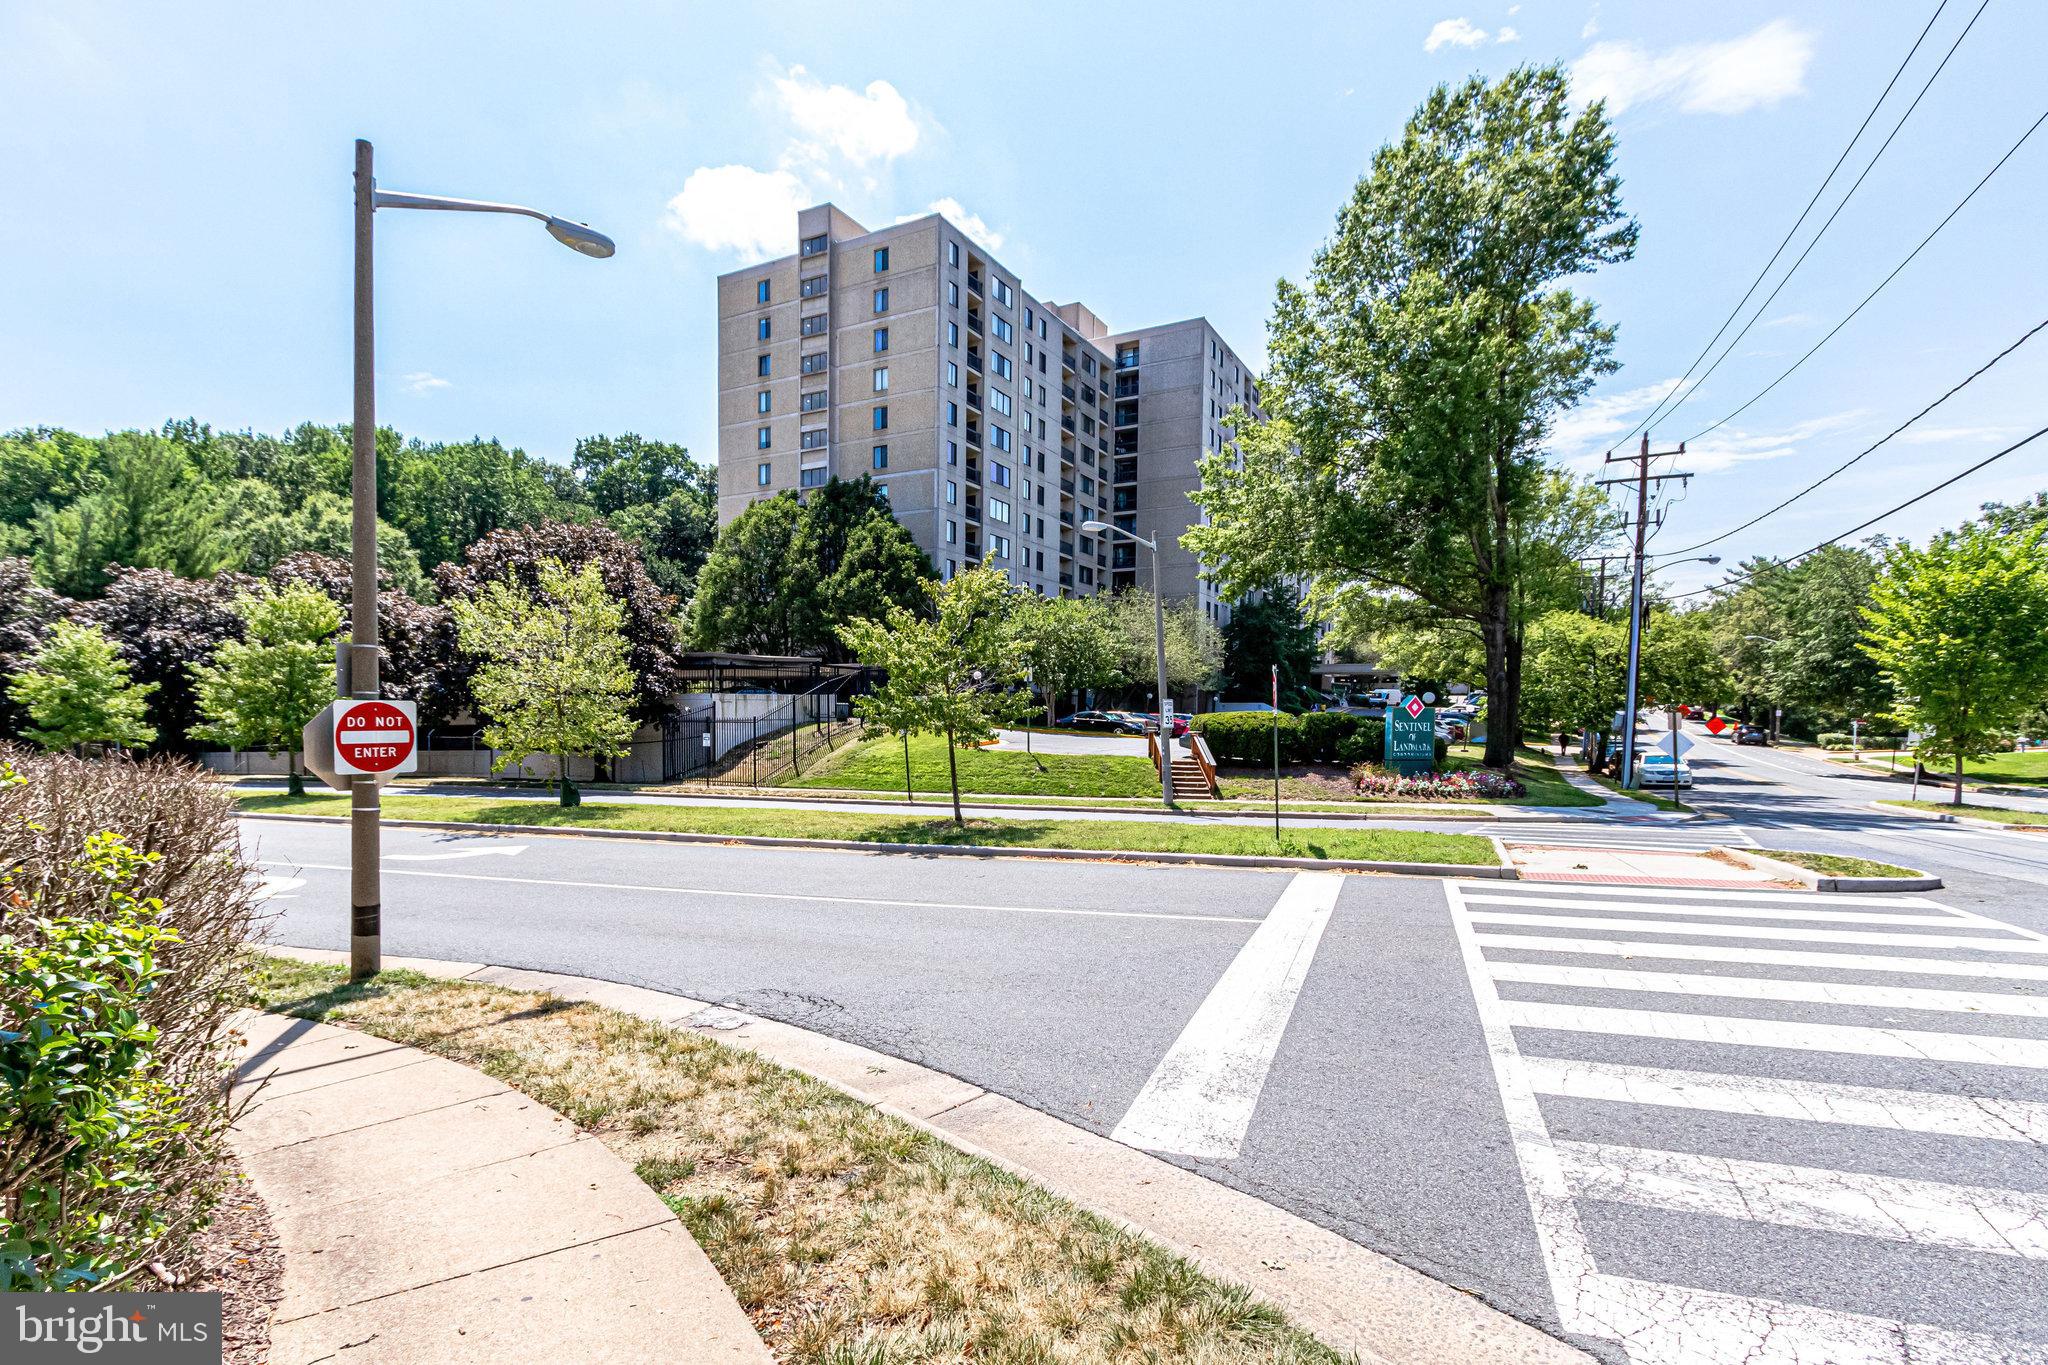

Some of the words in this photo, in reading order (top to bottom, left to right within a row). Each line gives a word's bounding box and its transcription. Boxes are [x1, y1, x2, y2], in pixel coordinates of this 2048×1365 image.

[346, 716, 366, 728] DO
[375, 716, 403, 727] NOT
[1394, 719, 1432, 732] SENTINEL
[1393, 740, 1431, 751] LANDMARK
[354, 746, 397, 759] ENTER
